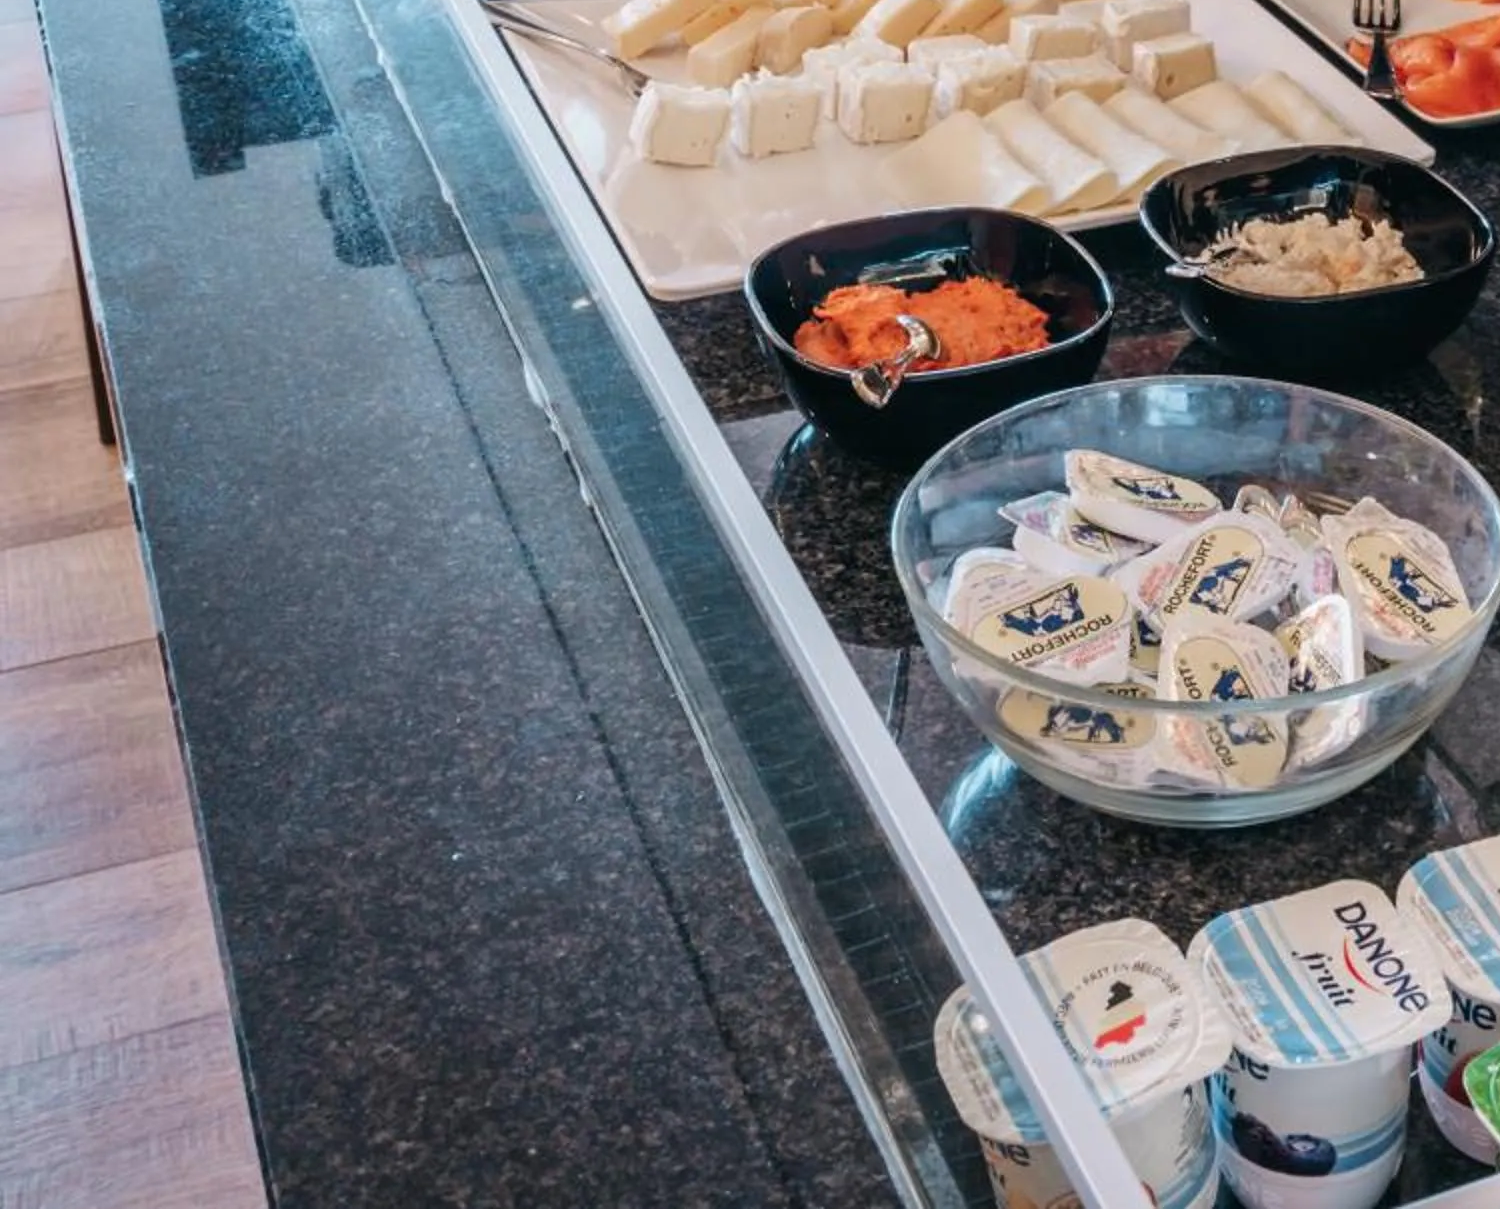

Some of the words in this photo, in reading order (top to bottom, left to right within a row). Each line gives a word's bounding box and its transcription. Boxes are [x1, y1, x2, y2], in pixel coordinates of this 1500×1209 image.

[1162, 536, 1214, 615] ROCHEFORT
[1353, 562, 1436, 633] ROCHEFORT
[1011, 614, 1113, 662] ROCHEFORT
[1290, 950, 1355, 1008] fruit
